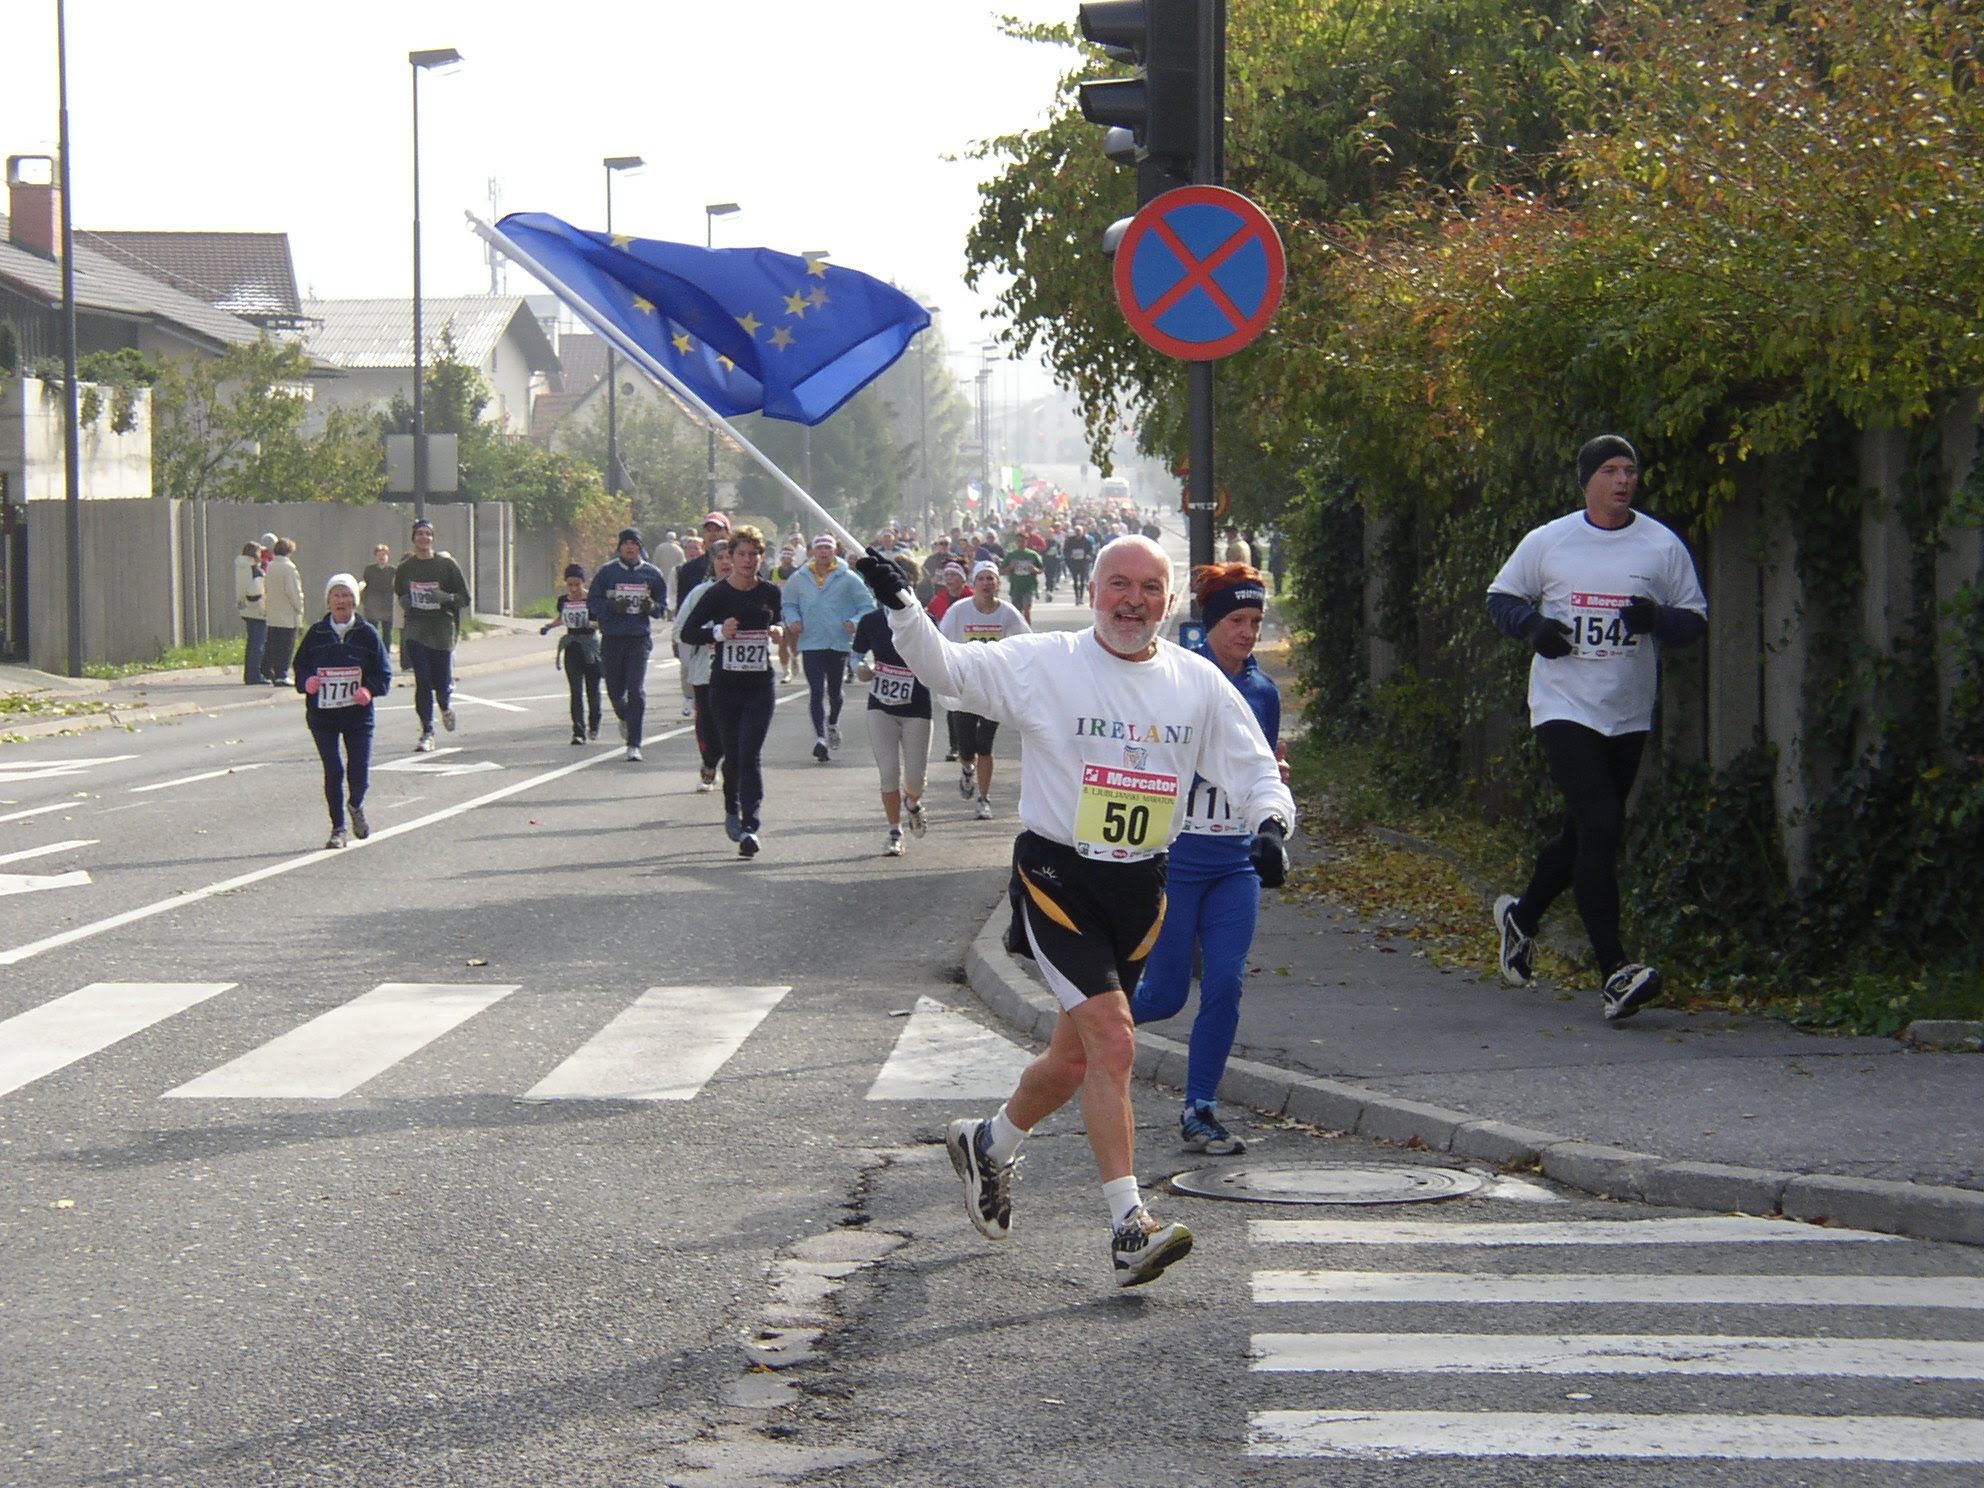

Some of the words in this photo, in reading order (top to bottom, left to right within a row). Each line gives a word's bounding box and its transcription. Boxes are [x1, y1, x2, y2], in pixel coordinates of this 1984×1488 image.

[727, 645, 765, 663] 1827
[322, 681, 360, 700] 1770
[873, 676, 911, 700] 1826
[1075, 717, 1193, 745] IRELAND
[1106, 771, 1177, 793] Mercator
[1102, 801, 1150, 846] 50
